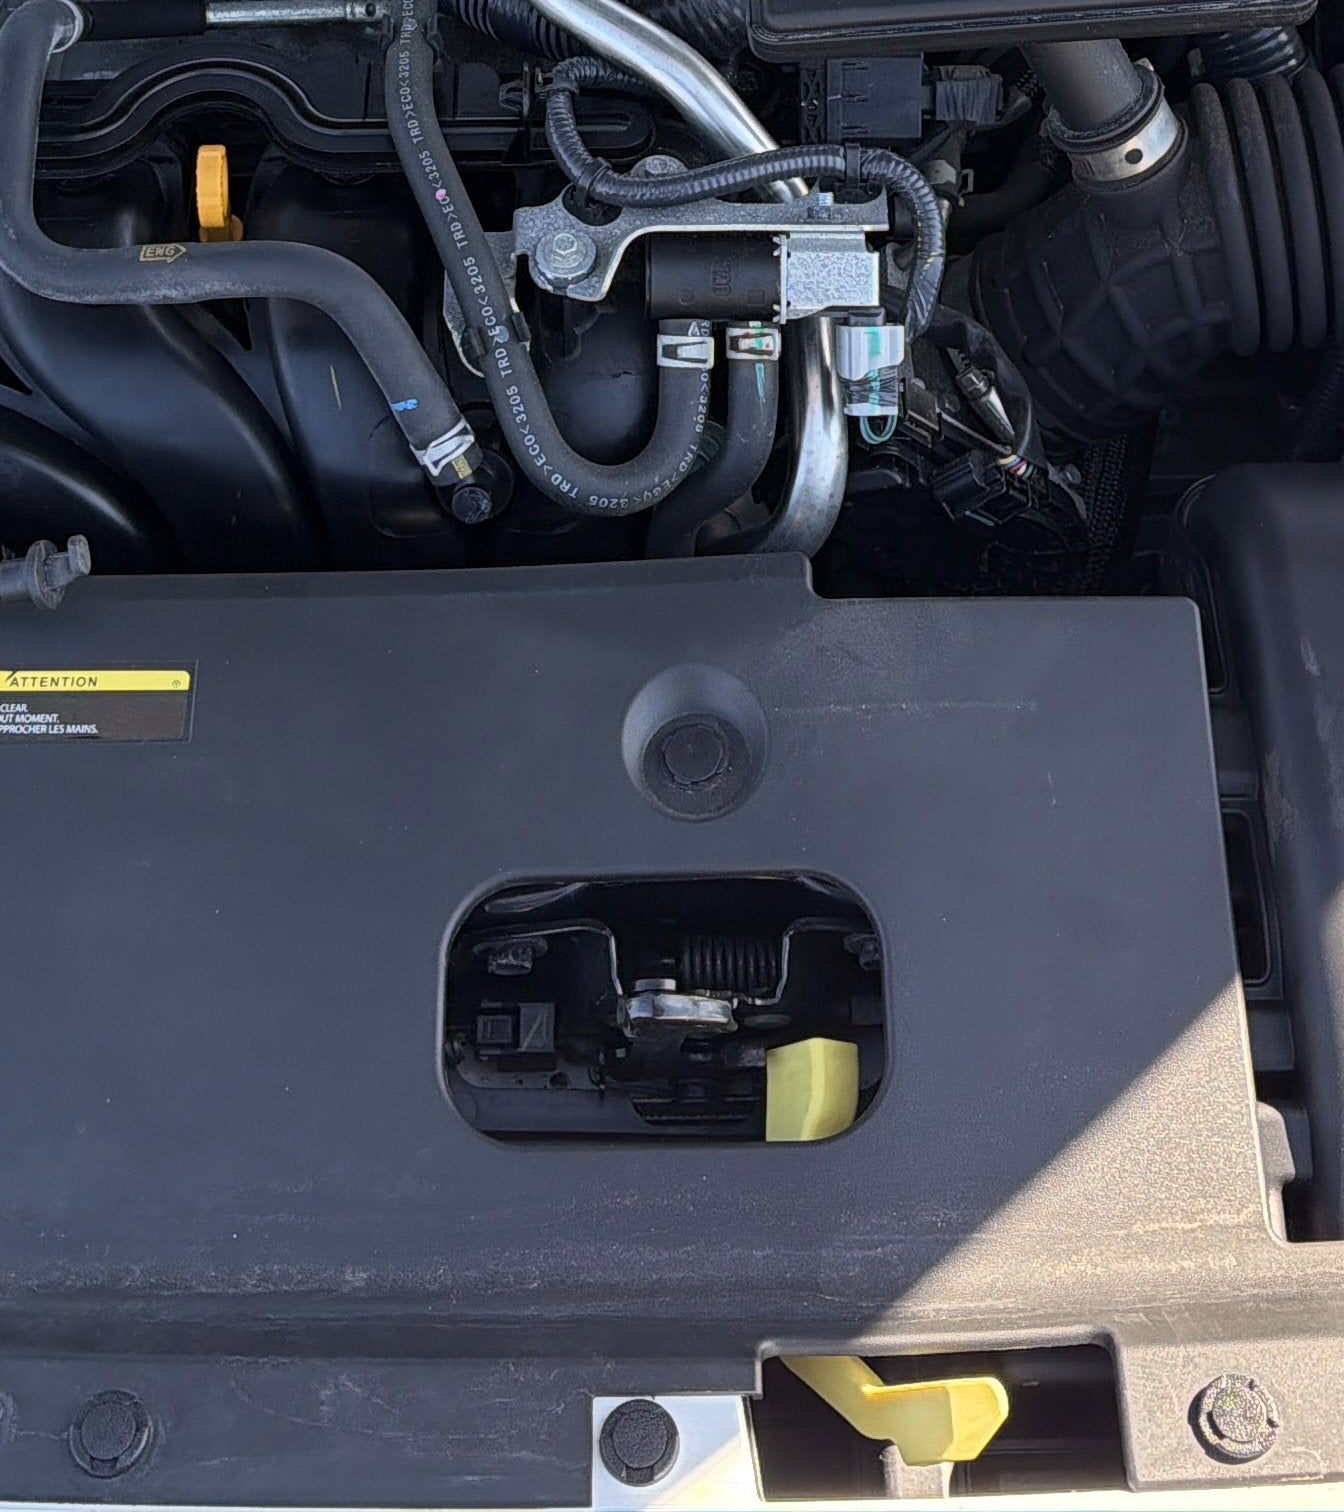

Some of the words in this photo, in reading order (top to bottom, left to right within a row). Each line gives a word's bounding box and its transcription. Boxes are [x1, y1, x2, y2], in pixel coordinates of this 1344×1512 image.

[419, 150, 468, 250] TRD>EC<3205
[145, 246, 176, 257] ENG
[9, 676, 98, 688] ATTENTION
[0, 702, 28, 713] CLEAR.
[15, 713, 60, 723] MOMENT.
[48, 723, 64, 734] LES
[65, 723, 99, 734] MAINS.
